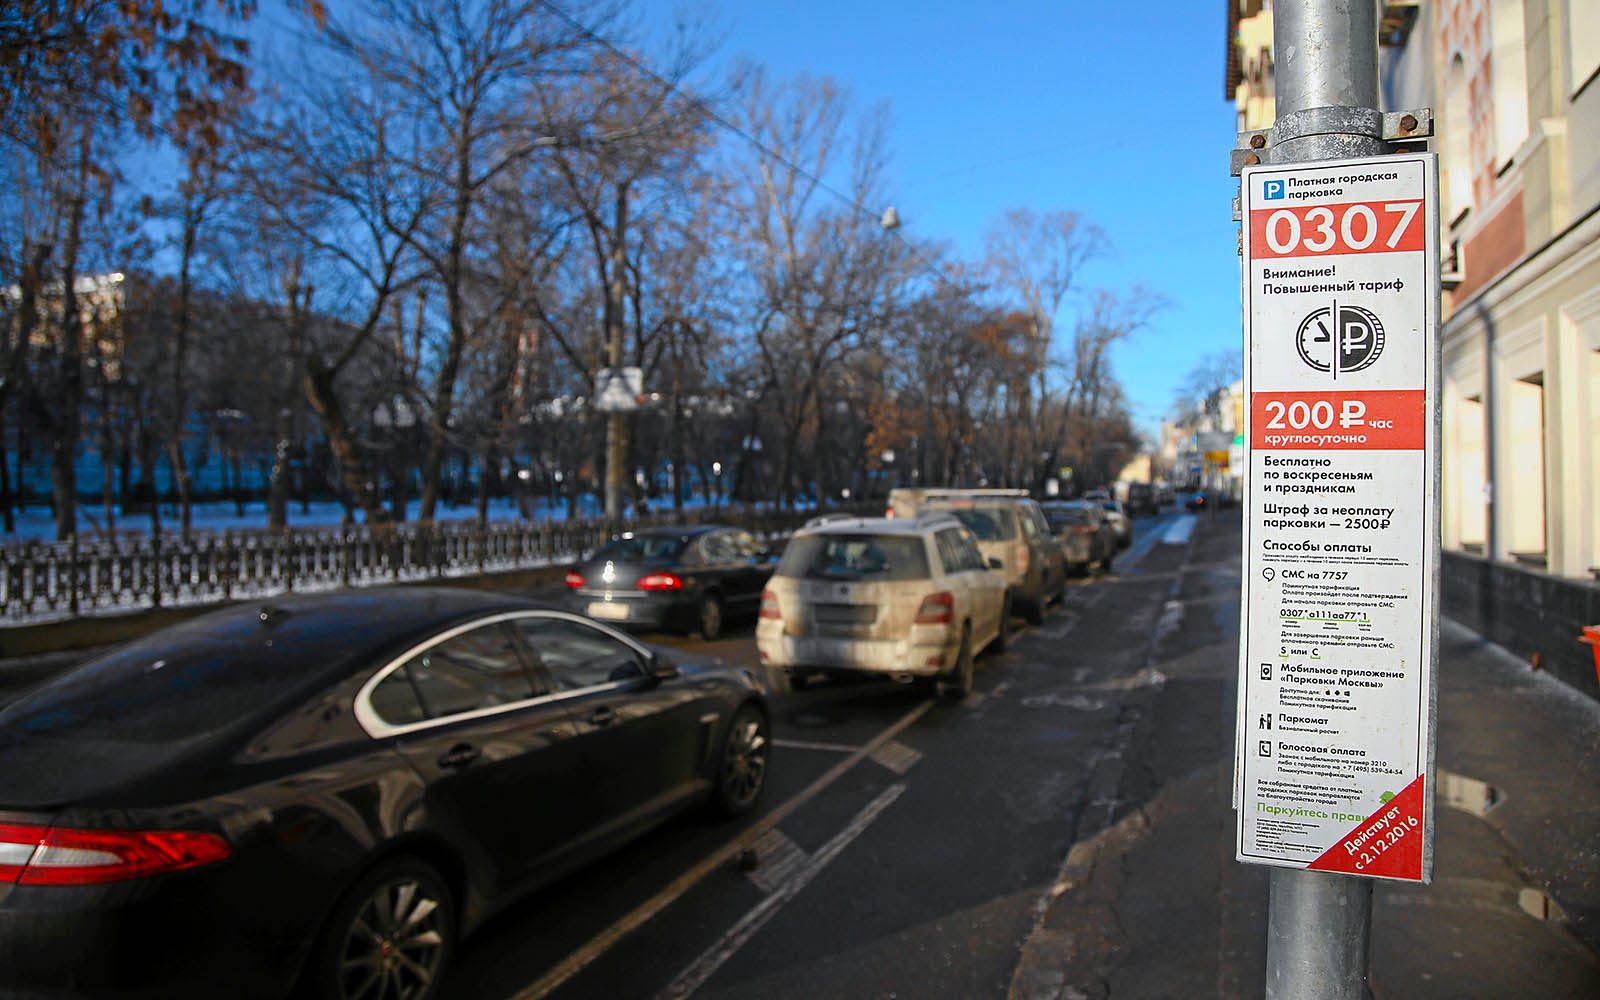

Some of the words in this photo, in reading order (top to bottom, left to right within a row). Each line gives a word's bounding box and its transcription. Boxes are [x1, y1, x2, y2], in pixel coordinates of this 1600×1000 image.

[1288, 178, 1335, 187] Платная
[1338, 172, 1398, 185] городская
[1288, 188, 1343, 200] парковка
[1266, 202, 1422, 254] 0307
[1263, 265, 1336, 279] Внимание!
[1263, 280, 1355, 294] Повышенный
[1359, 278, 1404, 292] тариф
[1264, 400, 1334, 429] 200
[1369, 420, 1393, 429] час
[1264, 434, 1366, 446] круглосуточно
[1264, 456, 1331, 467] Бесплатно
[1283, 472, 1373, 482] воскресеньям
[1264, 484, 1272, 492] и
[1275, 485, 1355, 495] праздникам
[1264, 504, 1310, 517] Штраф
[1314, 507, 1327, 515] за
[1332, 507, 1394, 519] неоплату
[1264, 519, 1326, 530] парковки
[1263, 539, 1320, 552] Способы
[1324, 543, 1372, 553] оплаты
[1282, 570, 1305, 579] СМС
[1322, 571, 1348, 580] 7757
[1281, 664, 1338, 675] Мобильное
[1340, 669, 1405, 679] приложение
[1280, 674, 1336, 685] «Парковки
[1338, 678, 1384, 688] Москвы»
[1279, 714, 1328, 724] Паркомат
[1278, 742, 1328, 753] Голосовая
[1330, 748, 1366, 756] оплата
[1353, 765, 1369, 773] (495)
[1371, 767, 1403, 775] 539-54-54
[1257, 802, 1328, 818] Паркуйтесь
[1343, 806, 1401, 856] Действует
[1355, 860, 1364, 870] с
[1360, 815, 1418, 863] 2.12.2016
